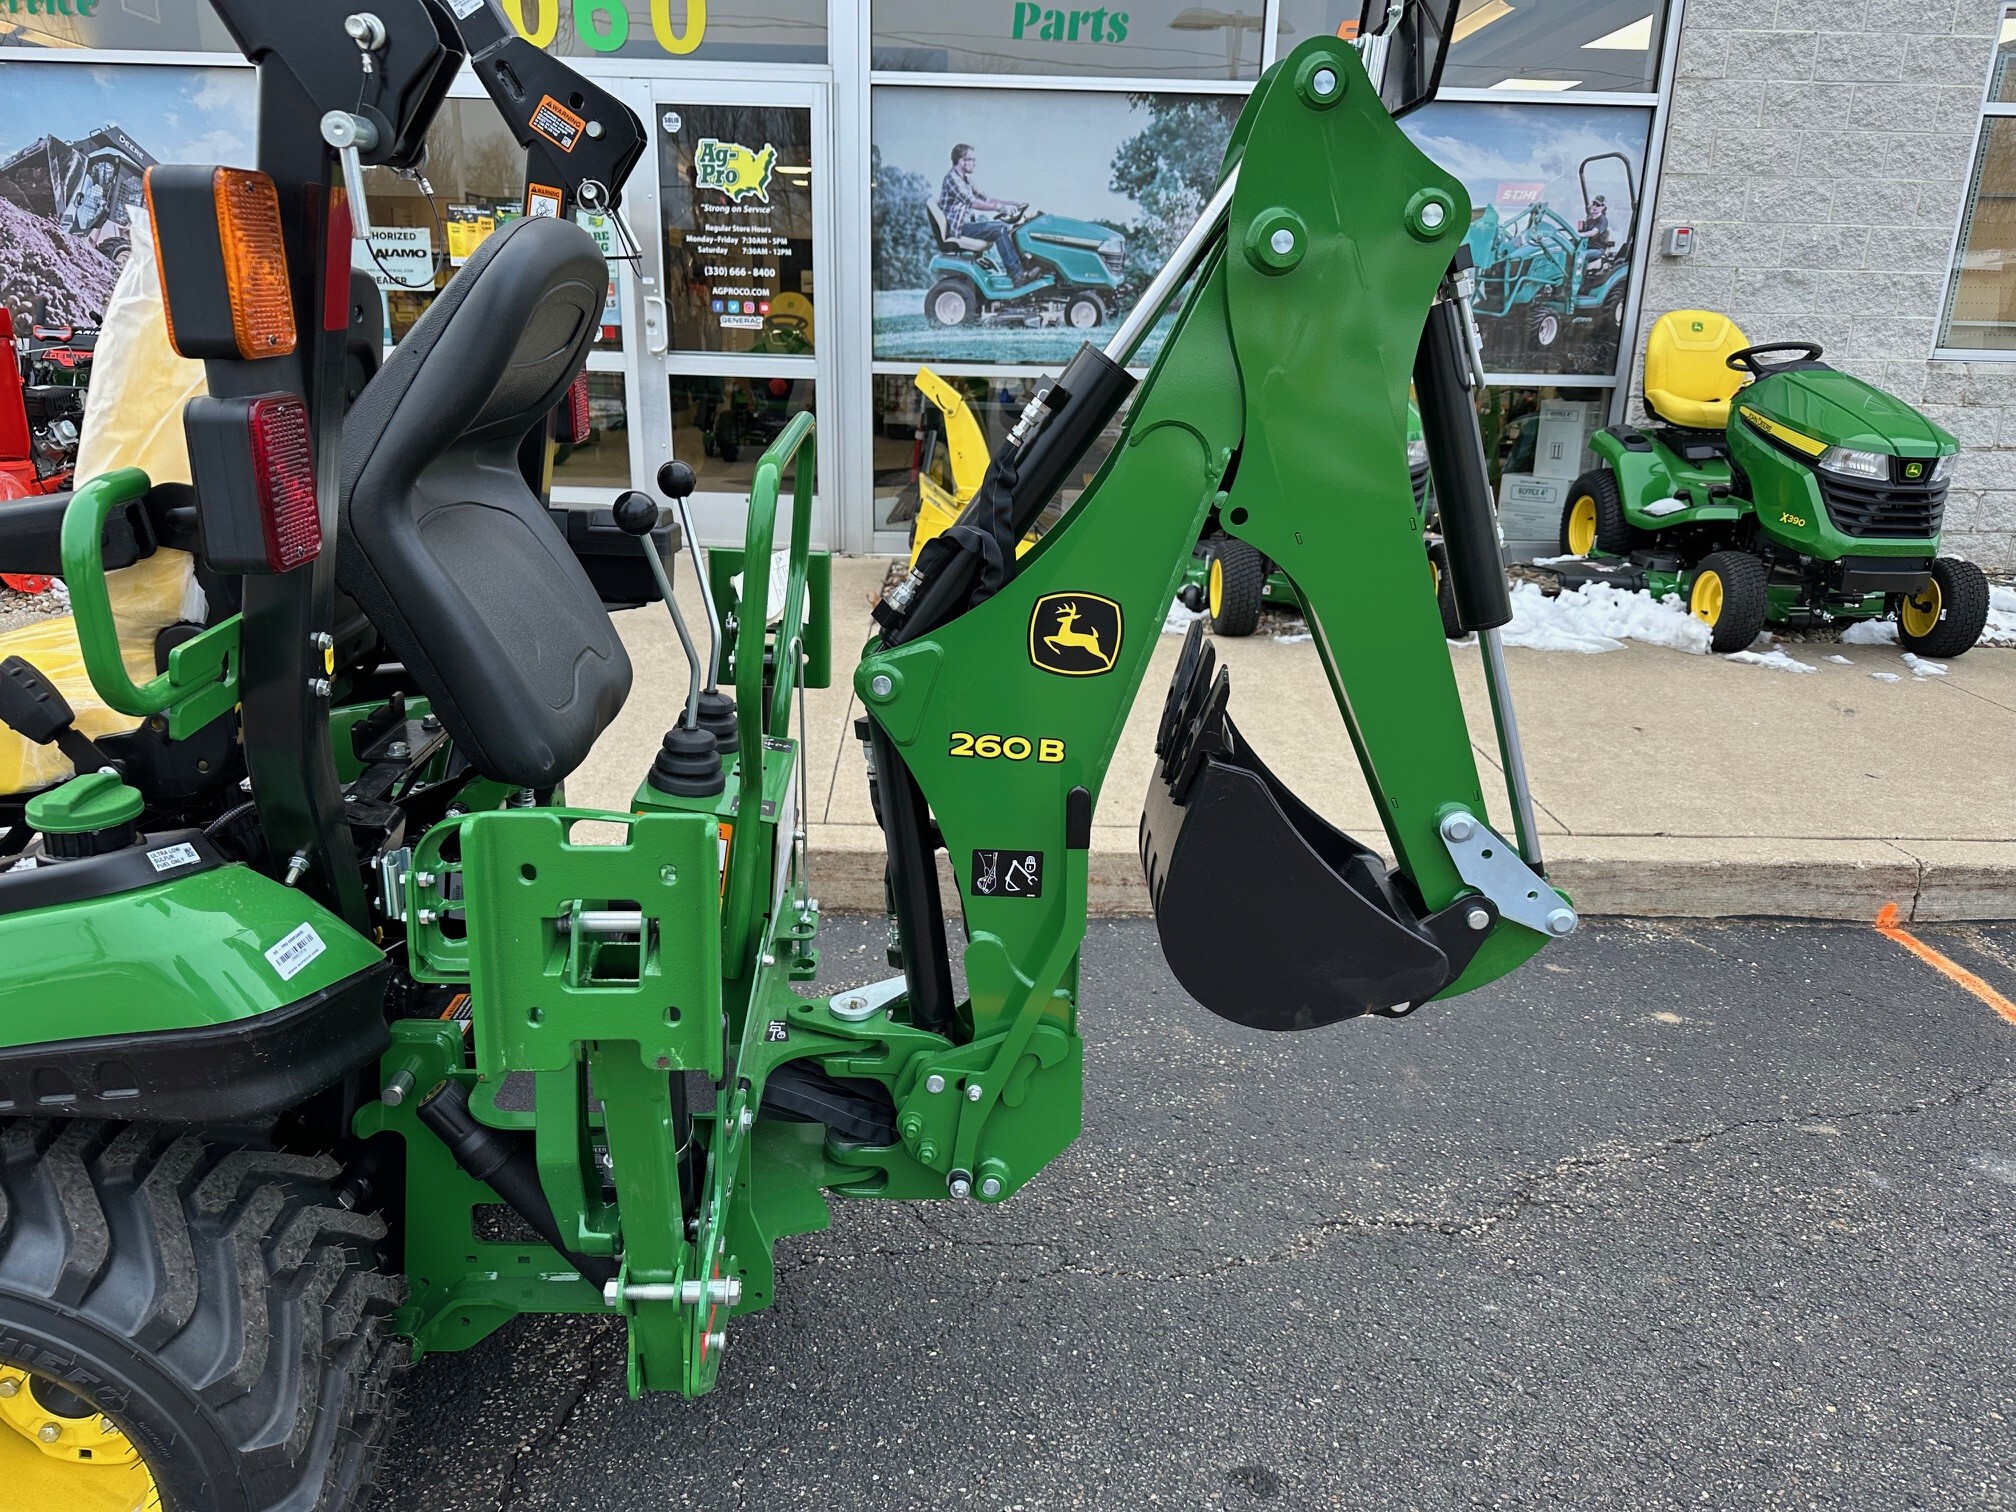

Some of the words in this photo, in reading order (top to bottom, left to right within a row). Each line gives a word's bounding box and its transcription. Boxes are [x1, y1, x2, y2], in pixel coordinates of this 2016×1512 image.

[1012, 2, 1130, 43] Parts
[552, 103, 582, 128] WARNING
[118, 134, 144, 160] DEERE
[700, 142, 738, 167] Ag-
[700, 164, 738, 185] Pro
[537, 187, 560, 198] WARNING
[1502, 189, 1538, 200] STIHL
[701, 204, 730, 214] "Strong
[743, 205, 775, 214] Service"
[705, 224, 731, 233] Regular
[732, 224, 750, 232] Store
[751, 225, 772, 233] Hours
[371, 232, 416, 240] HORIZED
[742, 237, 768, 245] 7:30AM
[772, 237, 788, 245] 5PM
[374, 248, 427, 260] ALAMO
[697, 246, 728, 255] Saturday
[773, 248, 792, 256] 12PM
[704, 266, 728, 277] (330)
[729, 267, 746, 277] 666
[752, 268, 776, 277] 8400
[374, 276, 407, 285] EALER
[712, 287, 770, 297] AGPROCO.COM
[721, 317, 761, 325] GENERAC
[1757, 417, 1772, 433] DEERE
[1779, 512, 1806, 528] X390
[949, 731, 1033, 761] 260
[1037, 737, 1066, 763] B
[150, 849, 169, 859] ULTRA
[154, 854, 175, 863] SULFUR
[156, 861, 172, 869] FUEL
[171, 857, 185, 865] ONLY
